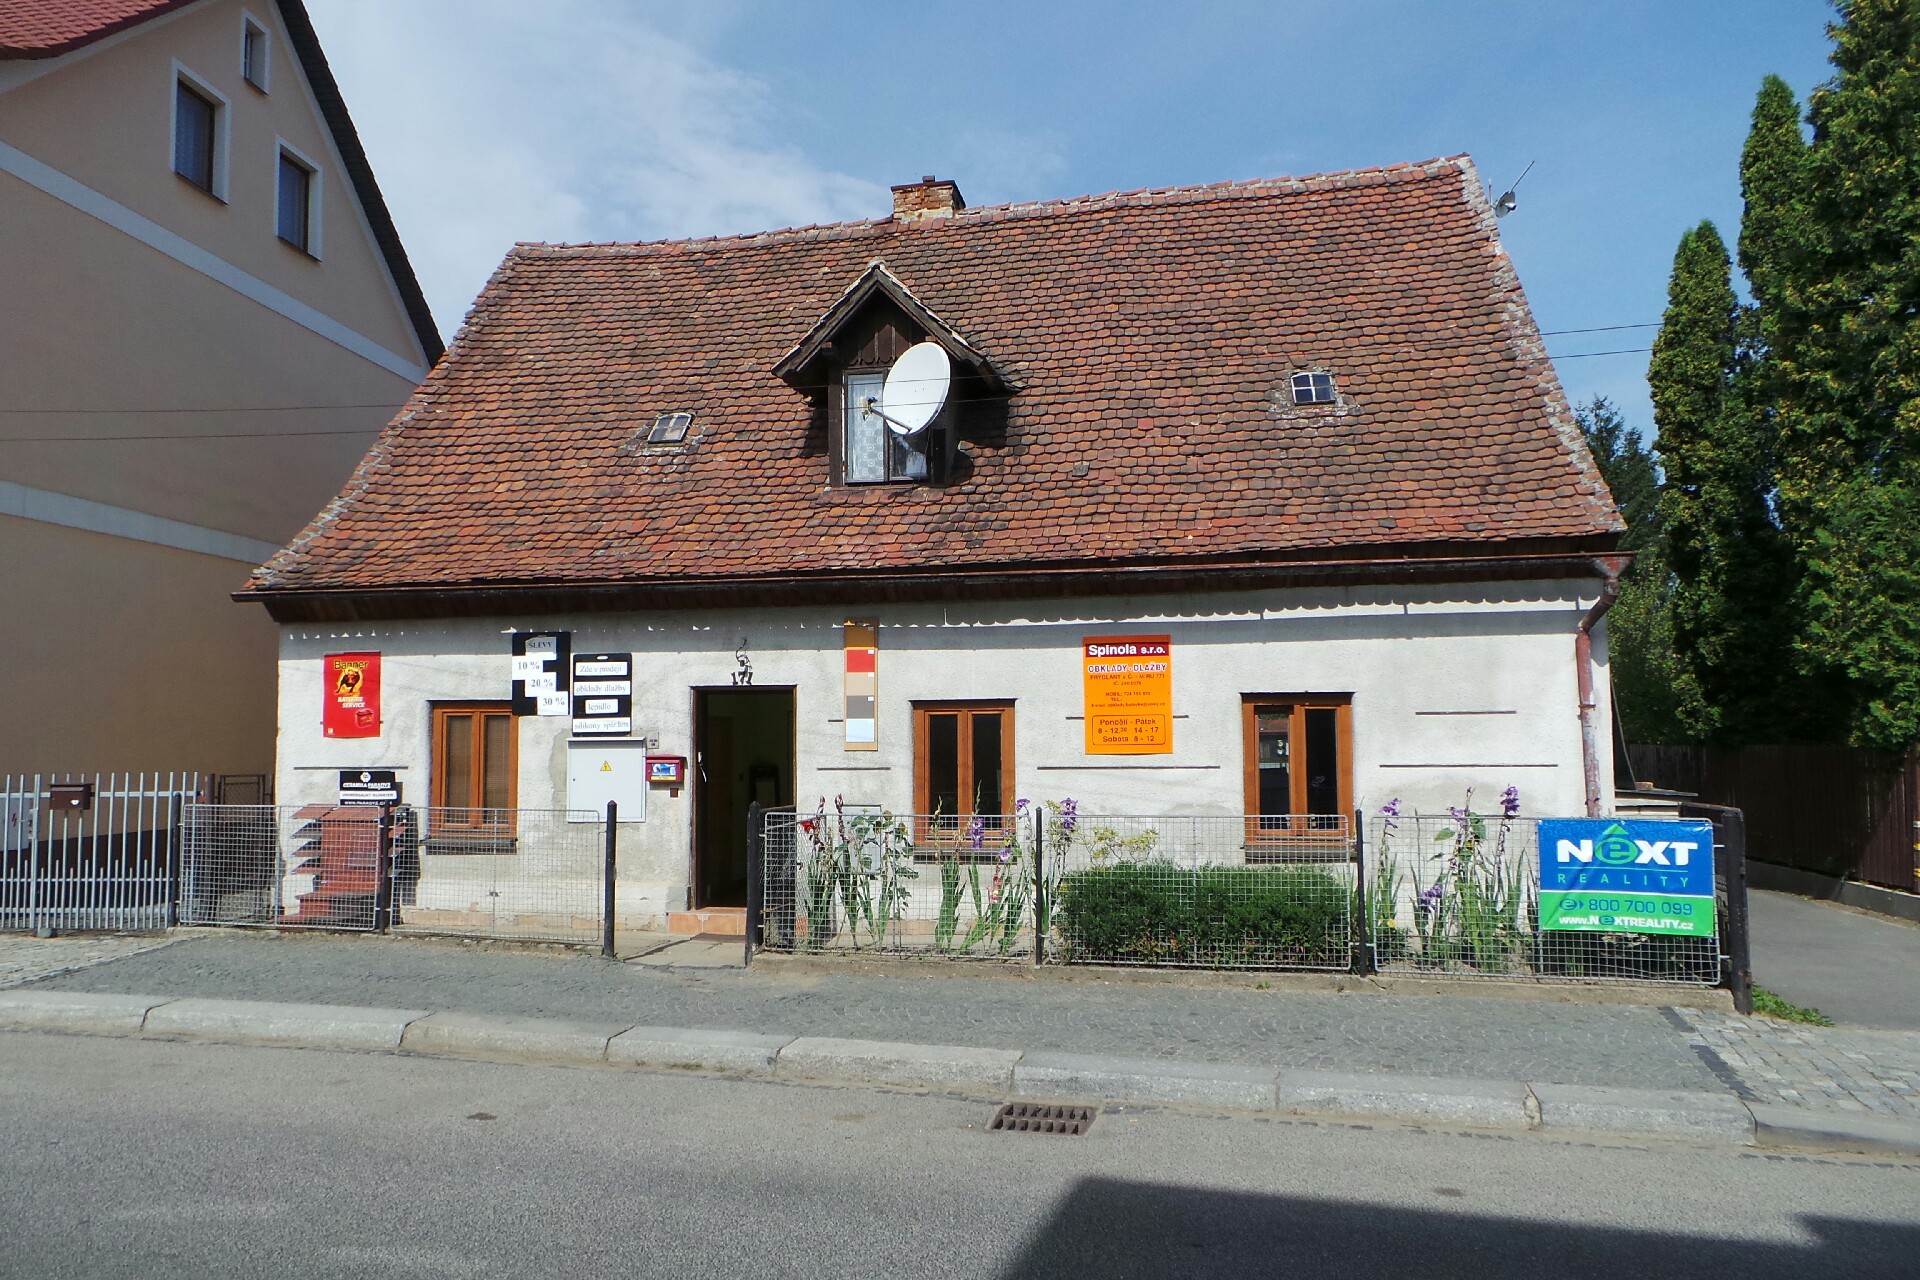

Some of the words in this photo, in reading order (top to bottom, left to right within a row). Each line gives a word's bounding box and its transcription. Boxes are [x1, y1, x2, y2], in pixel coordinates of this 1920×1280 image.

[528, 641, 553, 649] SLEVY
[1088, 644, 1137, 657] Spinola
[1140, 646, 1166, 654] s.r.o.
[334, 660, 369, 670] Banner
[518, 661, 528, 670] 10
[530, 661, 540, 670] %
[580, 665, 593, 673] Zde
[1088, 665, 1127, 673] OBKLADY
[1133, 662, 1167, 671] DLAŽBY
[731, 671, 754, 685] 171
[531, 679, 541, 688] 20
[543, 679, 553, 688] %
[576, 686, 602, 694] obklady
[604, 684, 626, 692] dlažby
[543, 698, 553, 706] 30
[555, 697, 565, 706] %
[588, 702, 612, 711] lepidlo
[574, 722, 602, 733] silikony
[1557, 873, 1690, 888] REALITY
[1588, 899, 1620, 911] 800
[1624, 900, 1656, 914] 700
[1661, 902, 1693, 915] 099
